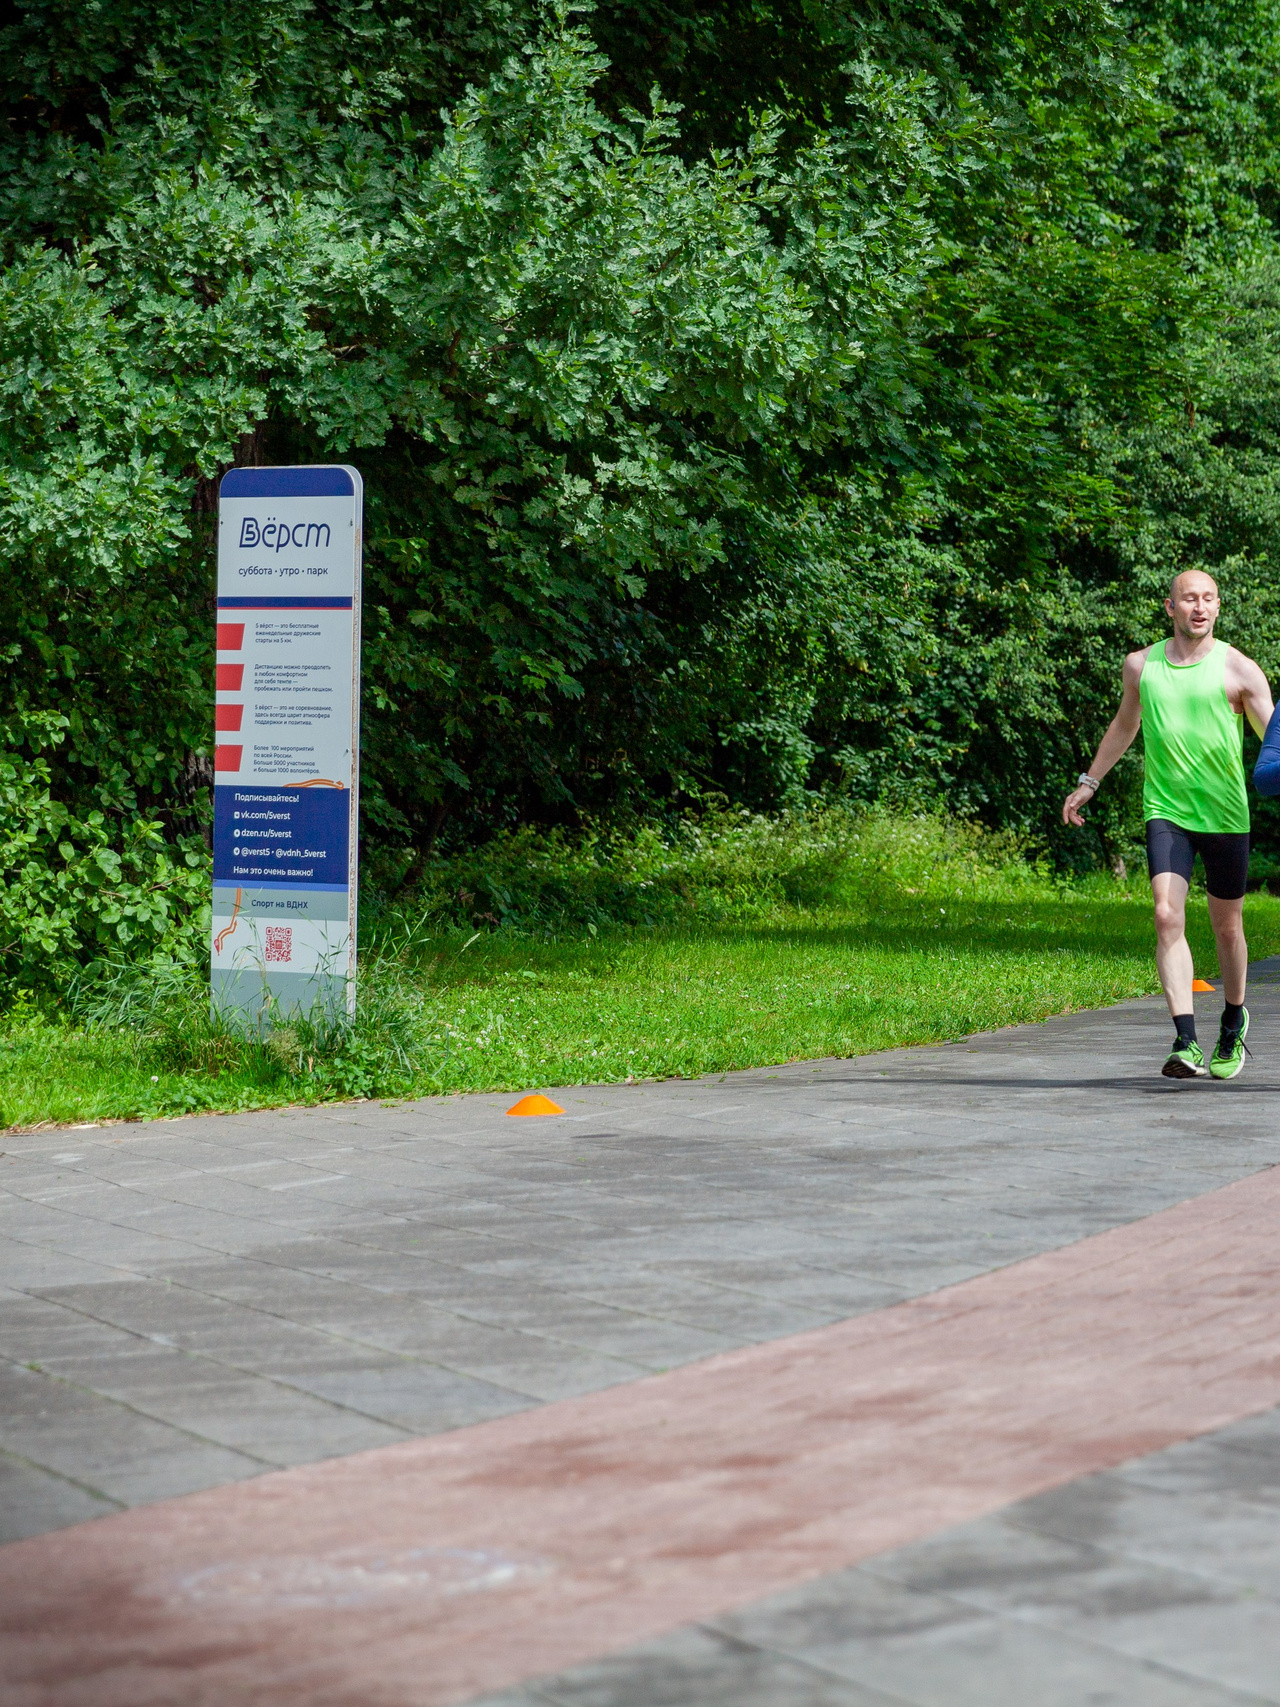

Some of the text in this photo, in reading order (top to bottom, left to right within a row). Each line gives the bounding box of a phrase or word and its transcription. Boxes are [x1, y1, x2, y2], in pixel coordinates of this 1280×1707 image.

[238, 565, 328, 577] суббота утро парк
[234, 792, 300, 803] Подписывайтесь!
[240, 810, 291, 820] vk.com/5verst
[241, 828, 292, 838] dzen.ru/5verst
[241, 847, 327, 858] @verst5 @vdnh_5verst
[233, 865, 314, 877] Нам это очень важно!
[251, 899, 275, 909] Спорт
[286, 900, 308, 909] ВДНХ
